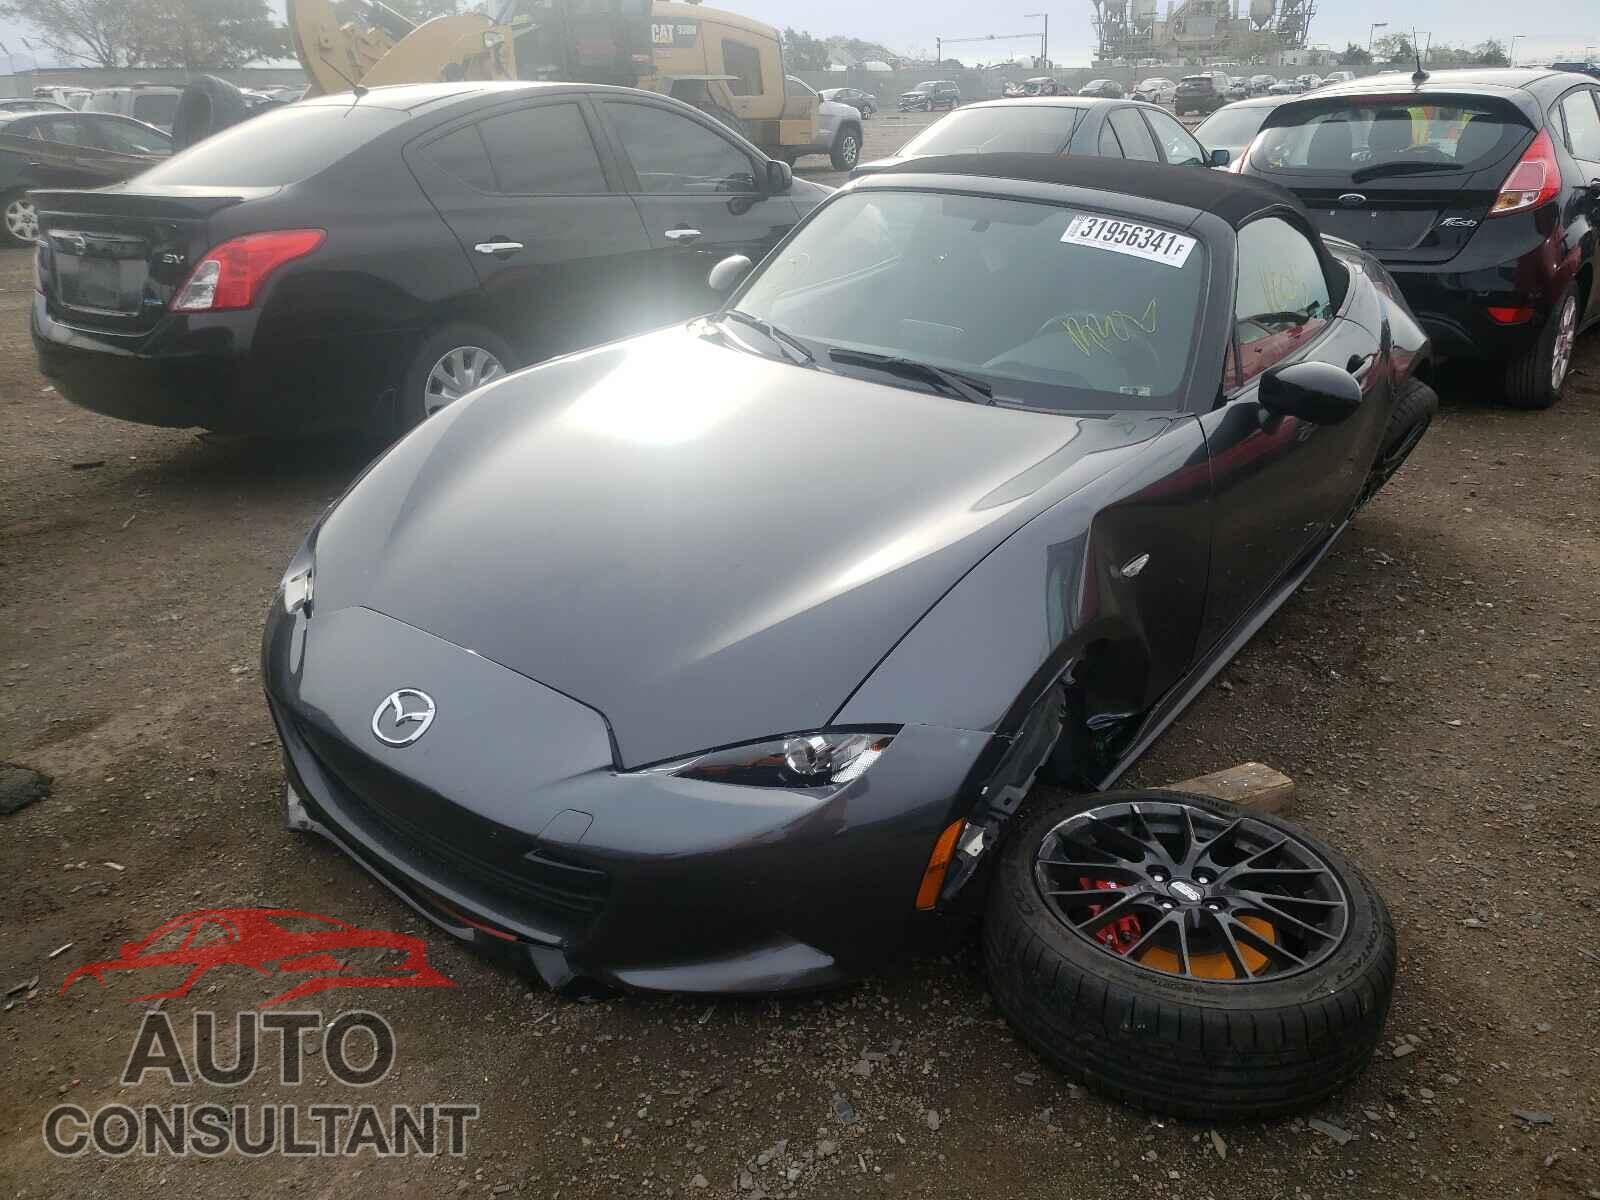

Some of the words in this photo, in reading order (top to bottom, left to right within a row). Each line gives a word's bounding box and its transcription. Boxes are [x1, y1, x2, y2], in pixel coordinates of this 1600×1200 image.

[651, 24, 674, 43] CAT
[1080, 218, 1177, 255] 31956341
[162, 253, 185, 264] SV
